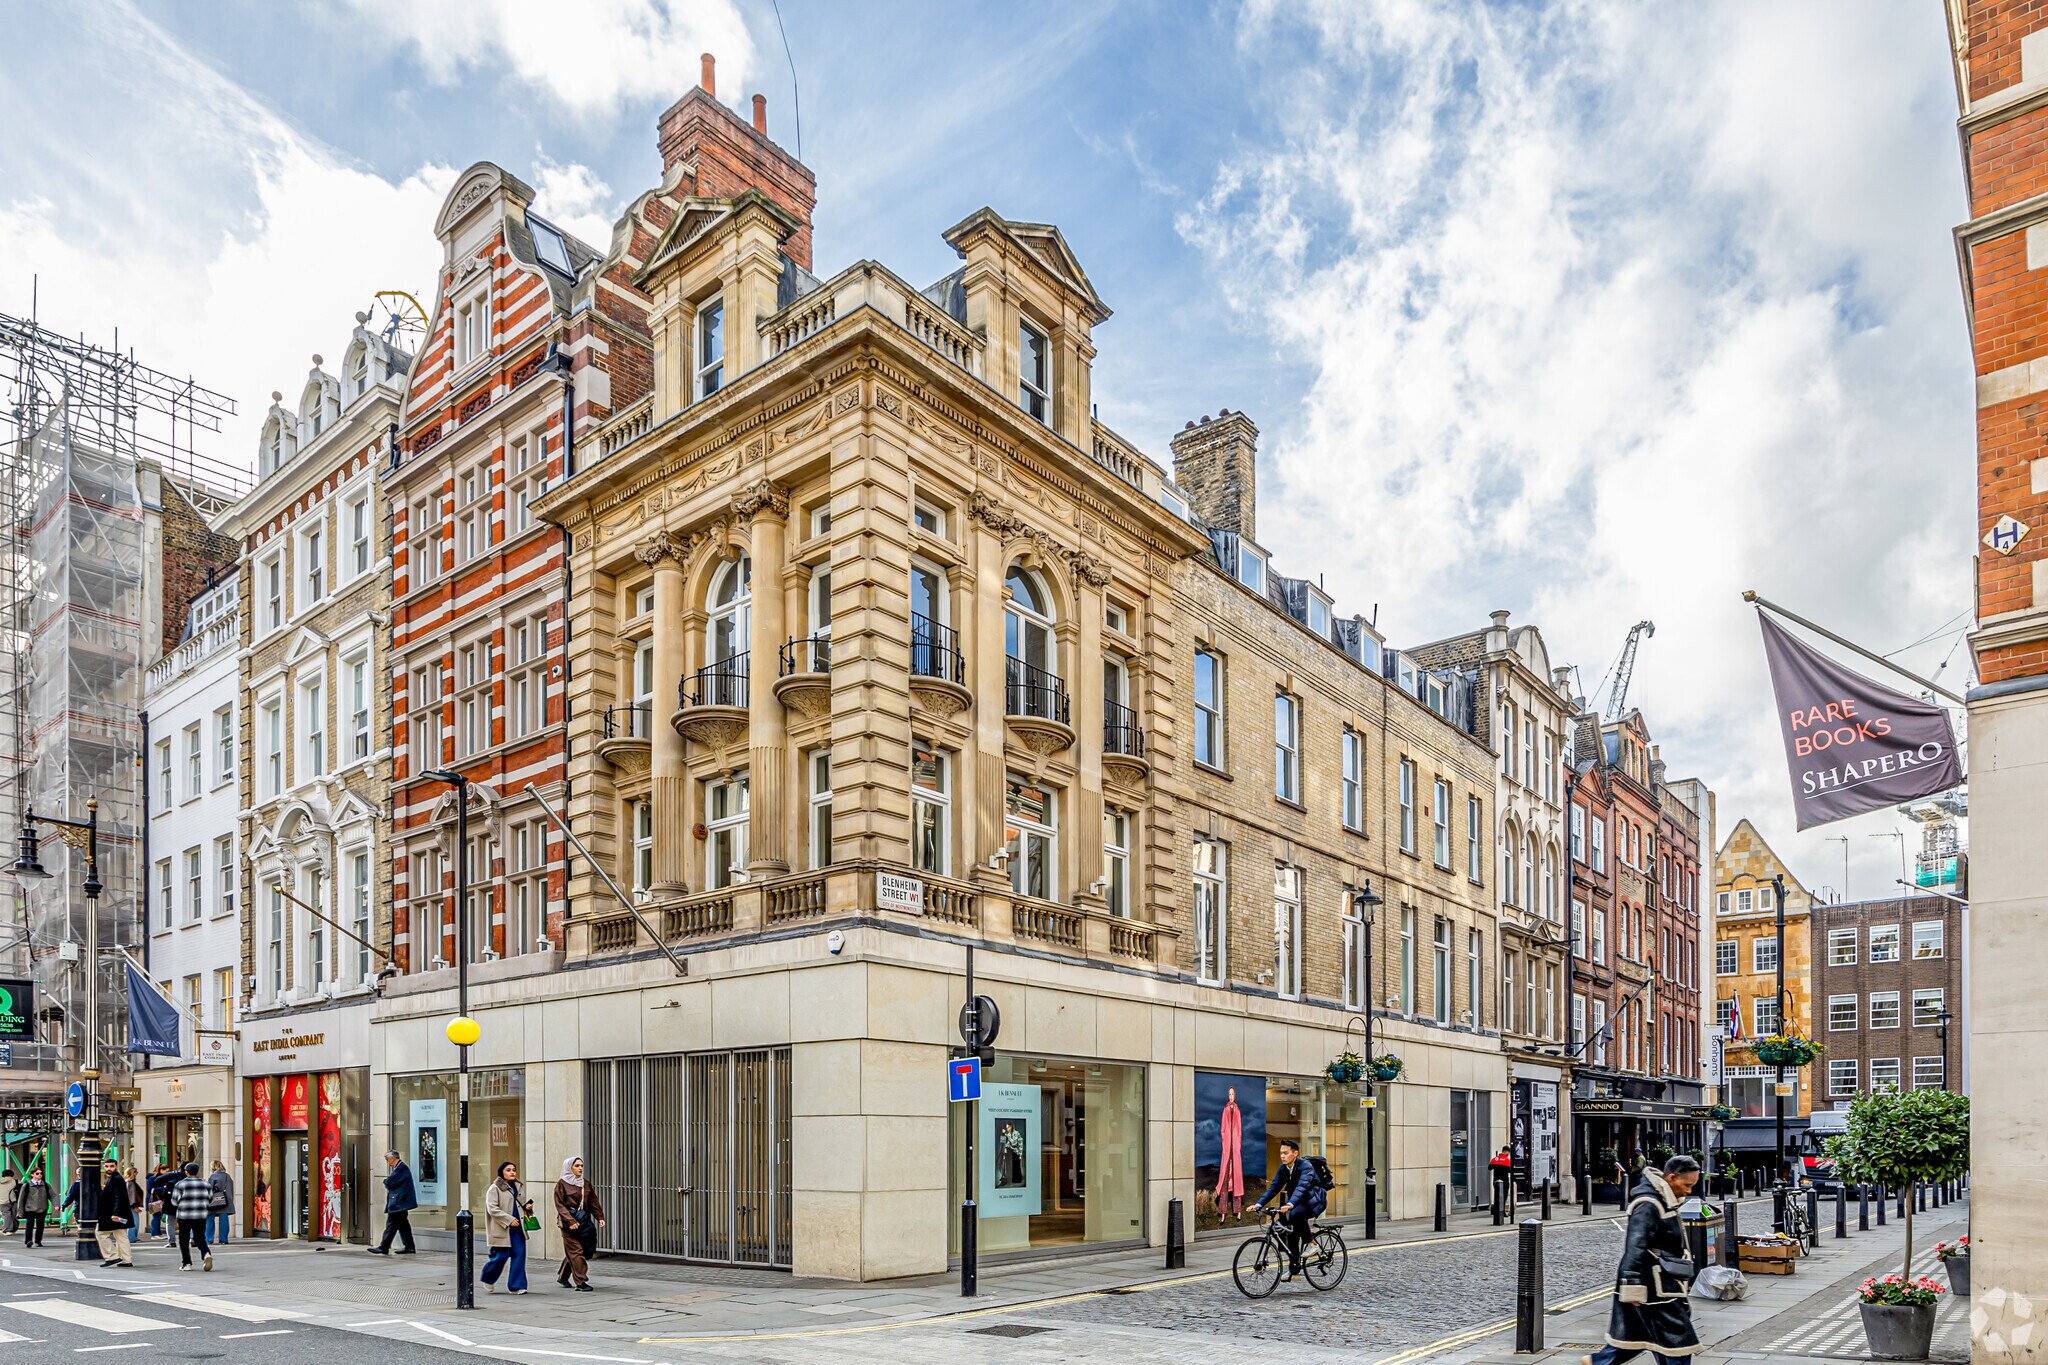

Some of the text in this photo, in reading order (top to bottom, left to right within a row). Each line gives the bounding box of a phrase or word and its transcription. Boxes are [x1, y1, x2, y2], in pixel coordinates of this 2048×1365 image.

[1994, 522, 2018, 548] H
[2003, 541, 2009, 549] 4
[1790, 699, 1858, 731] RARE
[1795, 717, 1891, 756] BOOKS
[1802, 741, 1943, 794] SHAPERO
[883, 876, 917, 891] BLENHEIM
[883, 888, 918, 903] STREET W1
[143, 1039, 175, 1049] BENNETT
[253, 1033, 325, 1052] EAST INDIA COMPANY
[1711, 1035, 1719, 1077] Bonhams
